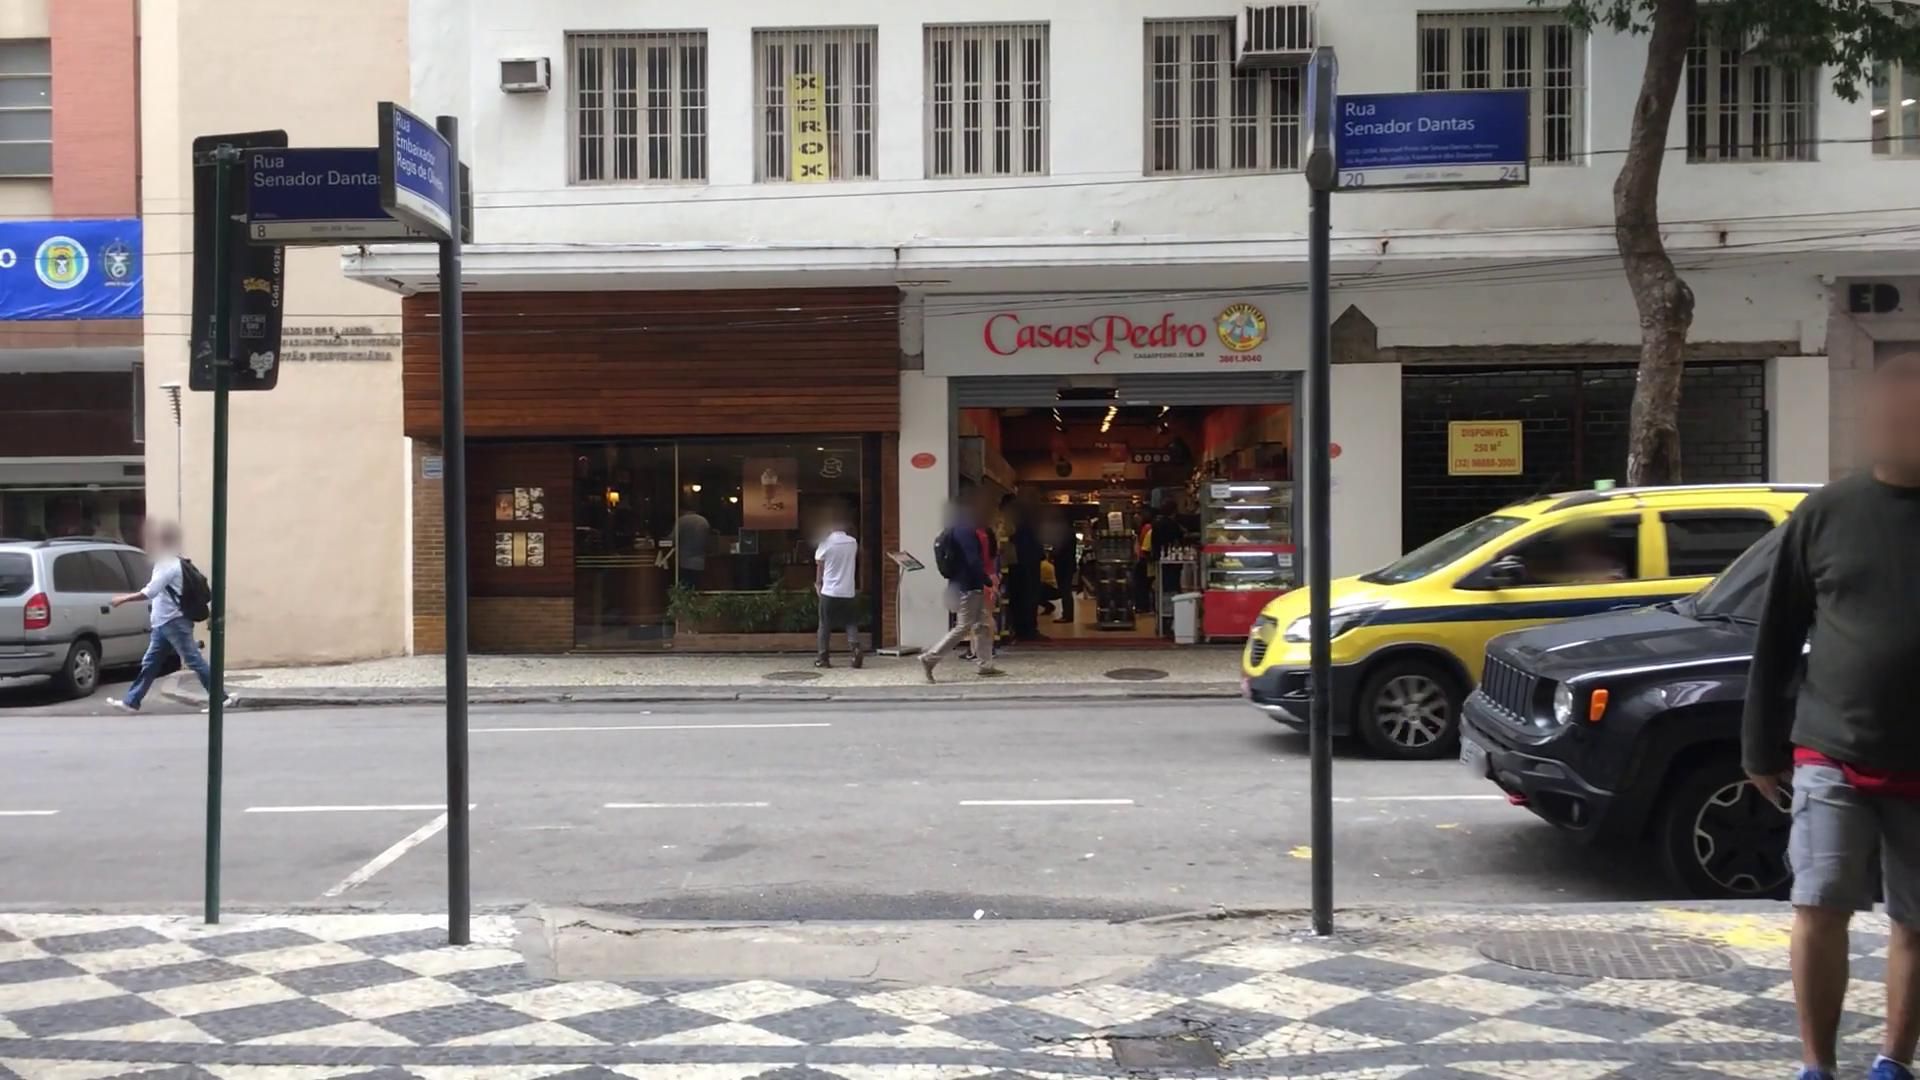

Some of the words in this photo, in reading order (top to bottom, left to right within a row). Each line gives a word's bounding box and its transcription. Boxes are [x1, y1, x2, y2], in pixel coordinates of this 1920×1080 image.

[1345, 102, 1376, 116] Rua
[395, 111, 411, 132] Rua
[796, 77, 824, 177] XEROX
[1345, 119, 1413, 136] Senador
[1418, 117, 1475, 132] Dantas
[254, 154, 285, 169] Rua
[254, 171, 323, 188] Senador
[1345, 172, 1365, 187] 20
[1500, 166, 1520, 180] 24
[258, 224, 266, 237] 8
